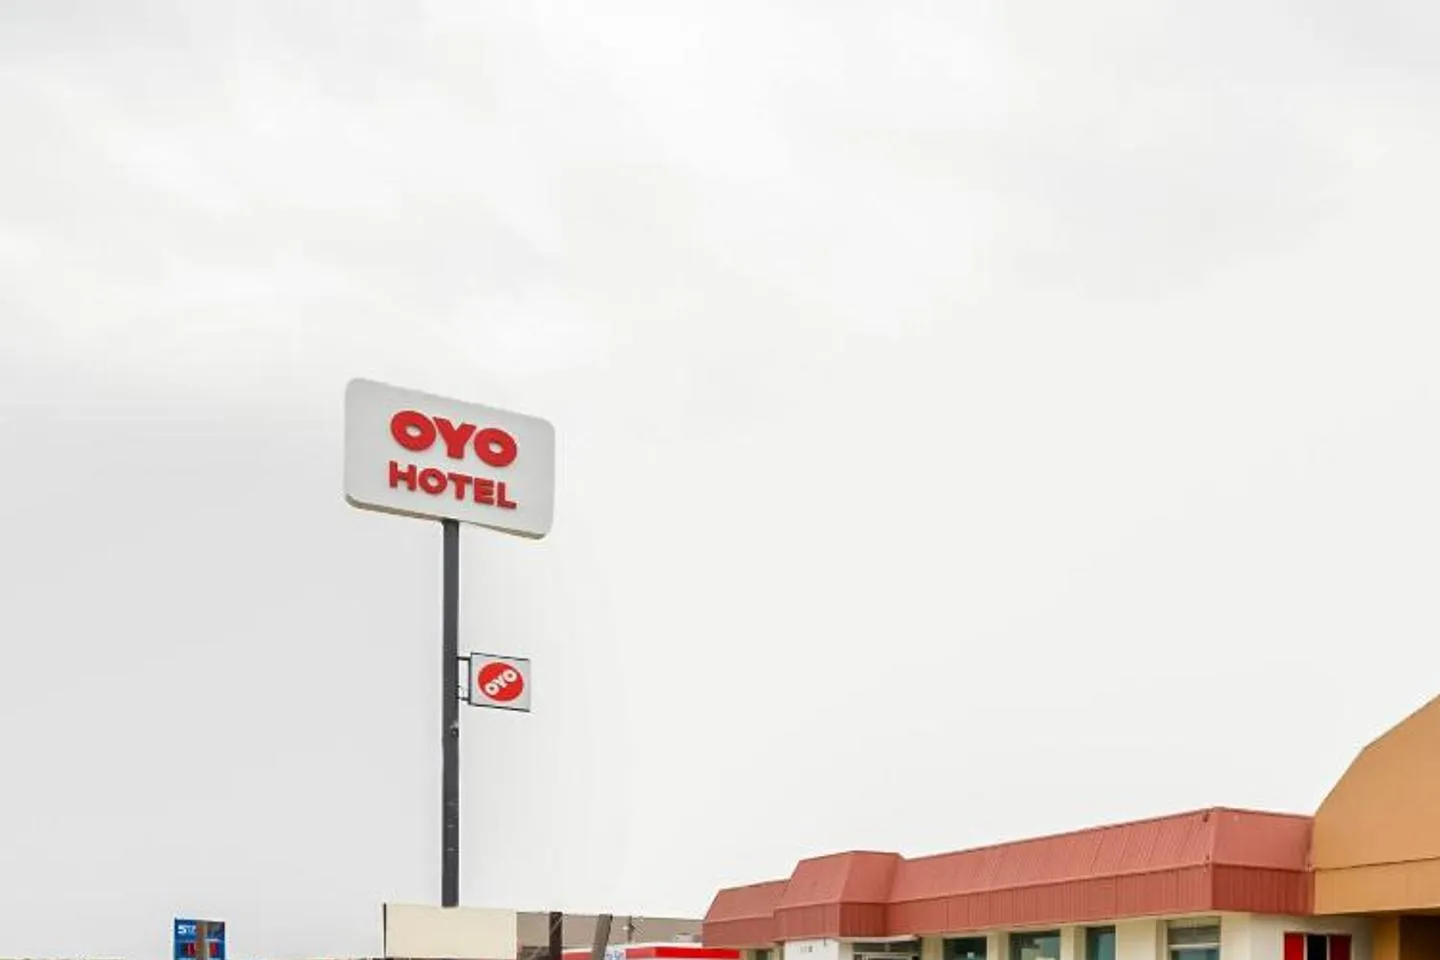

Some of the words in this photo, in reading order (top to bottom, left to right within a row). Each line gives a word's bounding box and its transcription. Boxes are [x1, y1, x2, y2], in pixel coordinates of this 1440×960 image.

[389, 410, 518, 468] OYO
[388, 460, 518, 510] HOTEL
[484, 668, 518, 696] OYO
